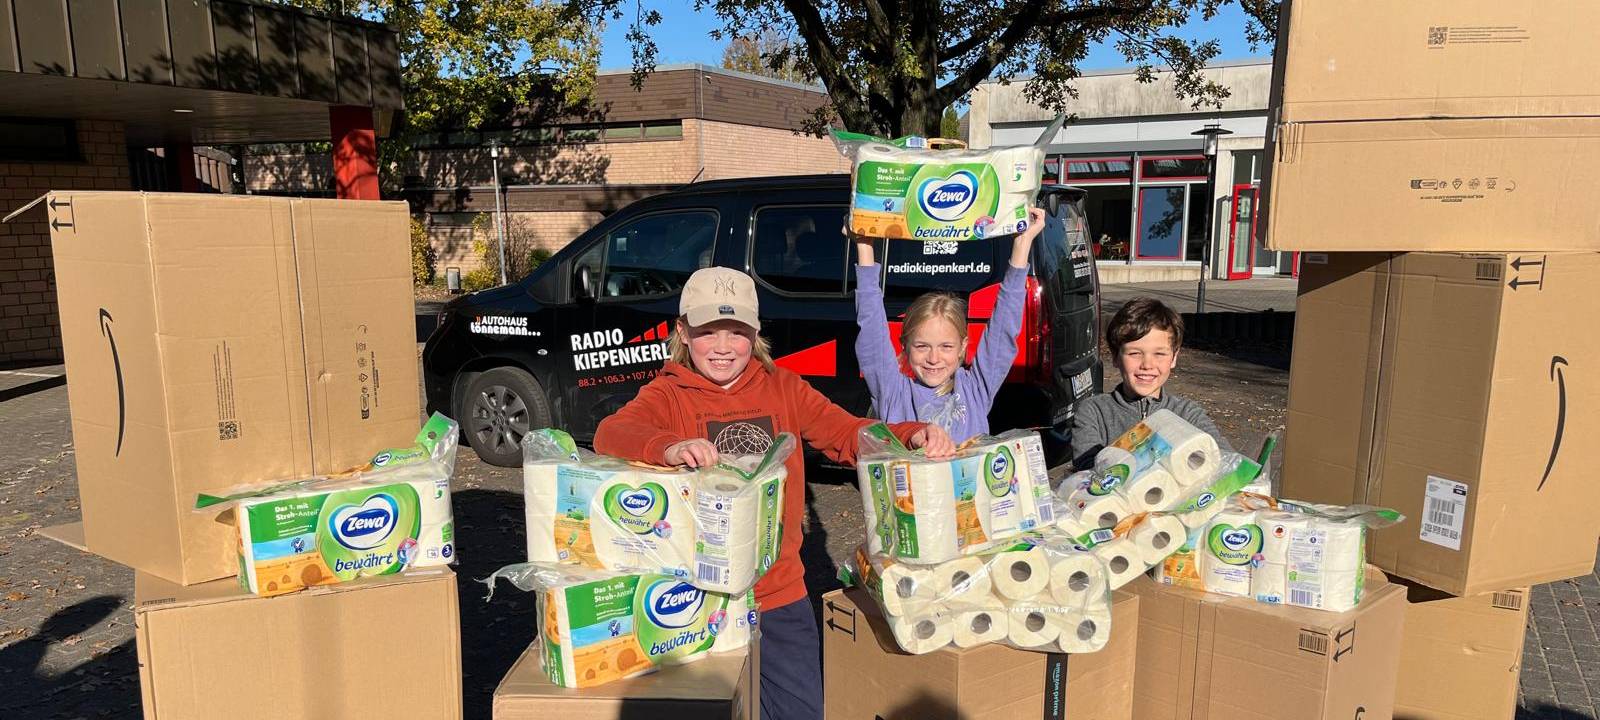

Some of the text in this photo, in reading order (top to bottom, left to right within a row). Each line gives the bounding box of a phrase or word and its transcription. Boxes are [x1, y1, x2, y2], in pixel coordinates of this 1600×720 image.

[932, 190, 966, 203] Zewa
[914, 226, 970, 238] bewährt
[888, 262, 991, 276] radiokiepenkerl.de
[481, 316, 528, 326] AUTOHAUS
[570, 328, 624, 351] RADIO
[573, 342, 671, 371] KIEPENKERL
[578, 377, 597, 388] 88.2
[603, 373, 626, 384] 106.3
[631, 370, 654, 380] 107.4
[626, 496, 648, 506] Zewa
[347, 514, 386, 531] Zewa
[335, 553, 394, 573] bewährt
[661, 589, 697, 608] Zewa
[650, 627, 706, 656] bewährt
